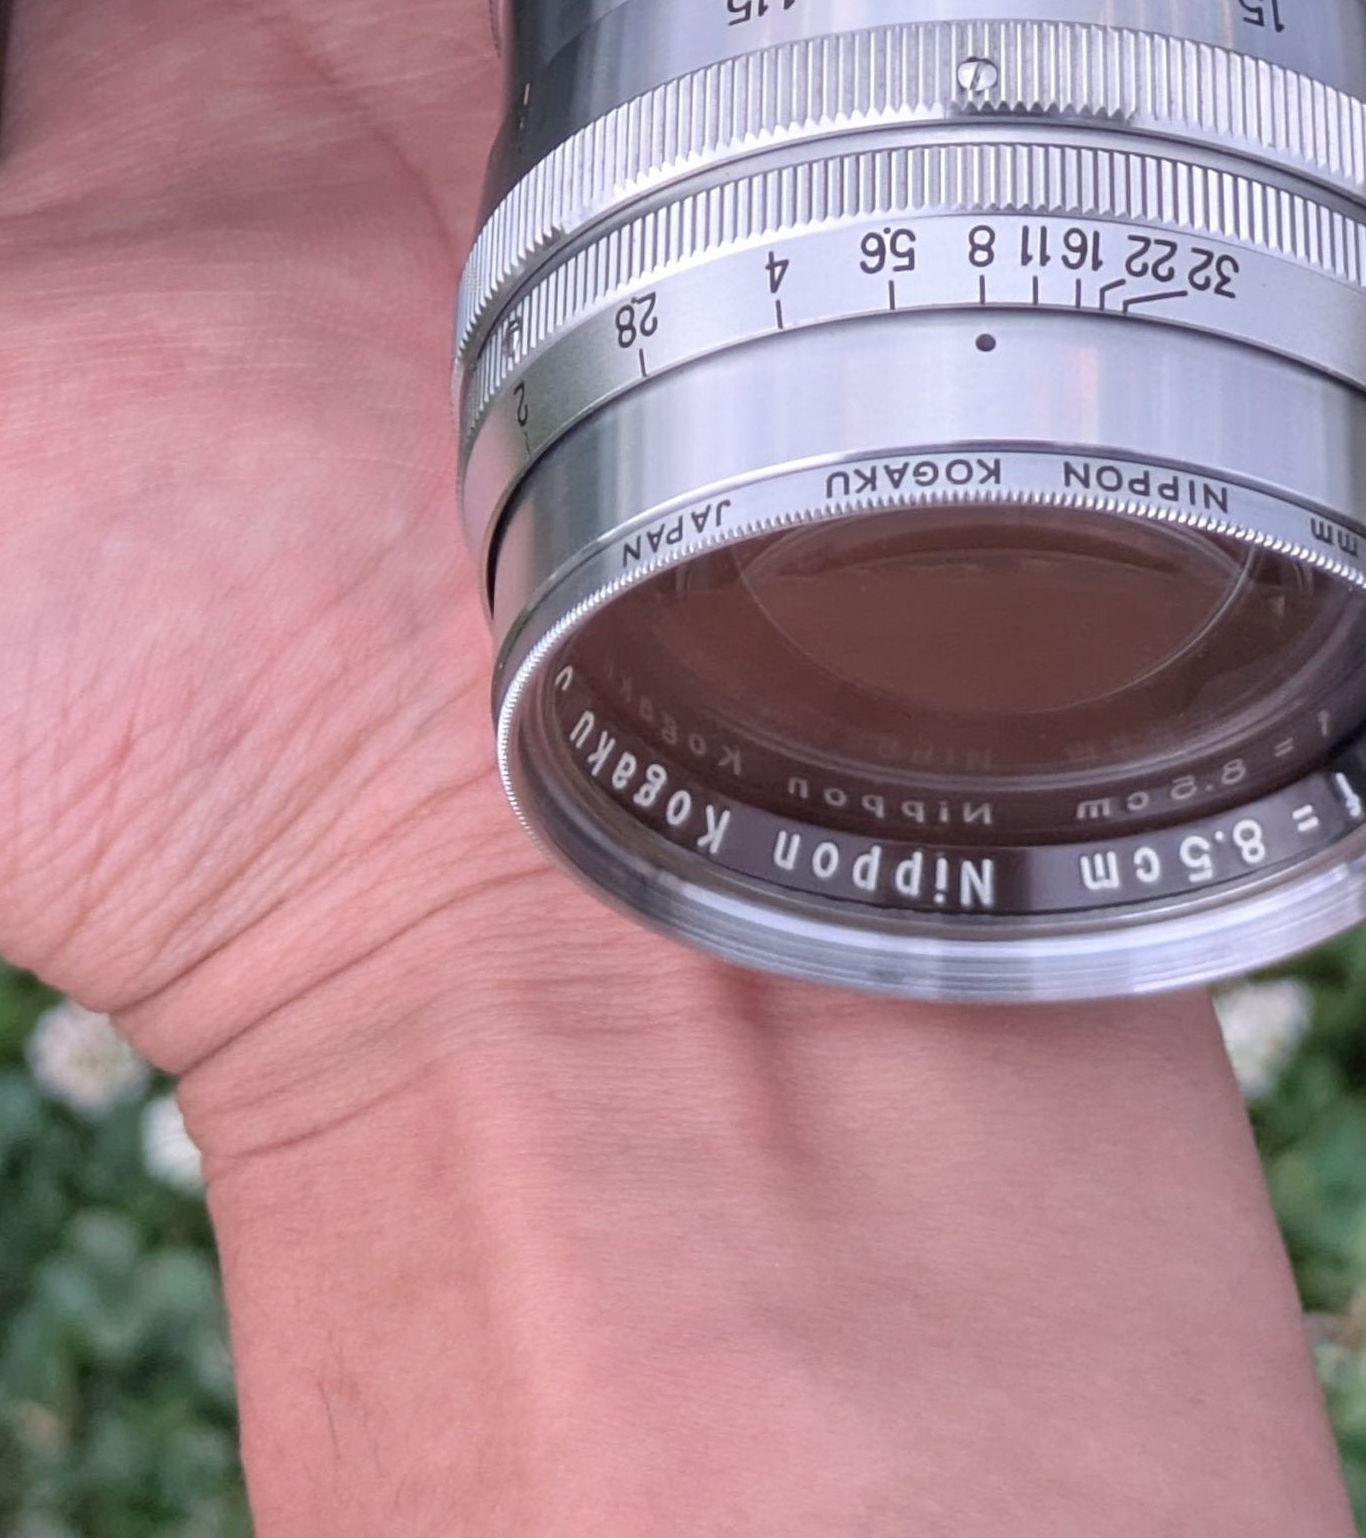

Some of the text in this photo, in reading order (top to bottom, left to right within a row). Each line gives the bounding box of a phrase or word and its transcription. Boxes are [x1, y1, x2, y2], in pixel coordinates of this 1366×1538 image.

[859, 226, 917, 274] 5.6
[967, 224, 997, 268] 8
[1020, 224, 1051, 267] 11
[1060, 226, 1104, 272] 16
[1124, 234, 1178, 283] 22
[764, 250, 790, 294] 4
[1187, 246, 1240, 299] 32
[512, 379, 529, 428] 2
[825, 457, 1228, 514] NIPPON KOGAKU
[622, 498, 732, 568] JAPAN
[568, 710, 732, 855] Kogaku
[772, 829, 995, 908] Nippon
